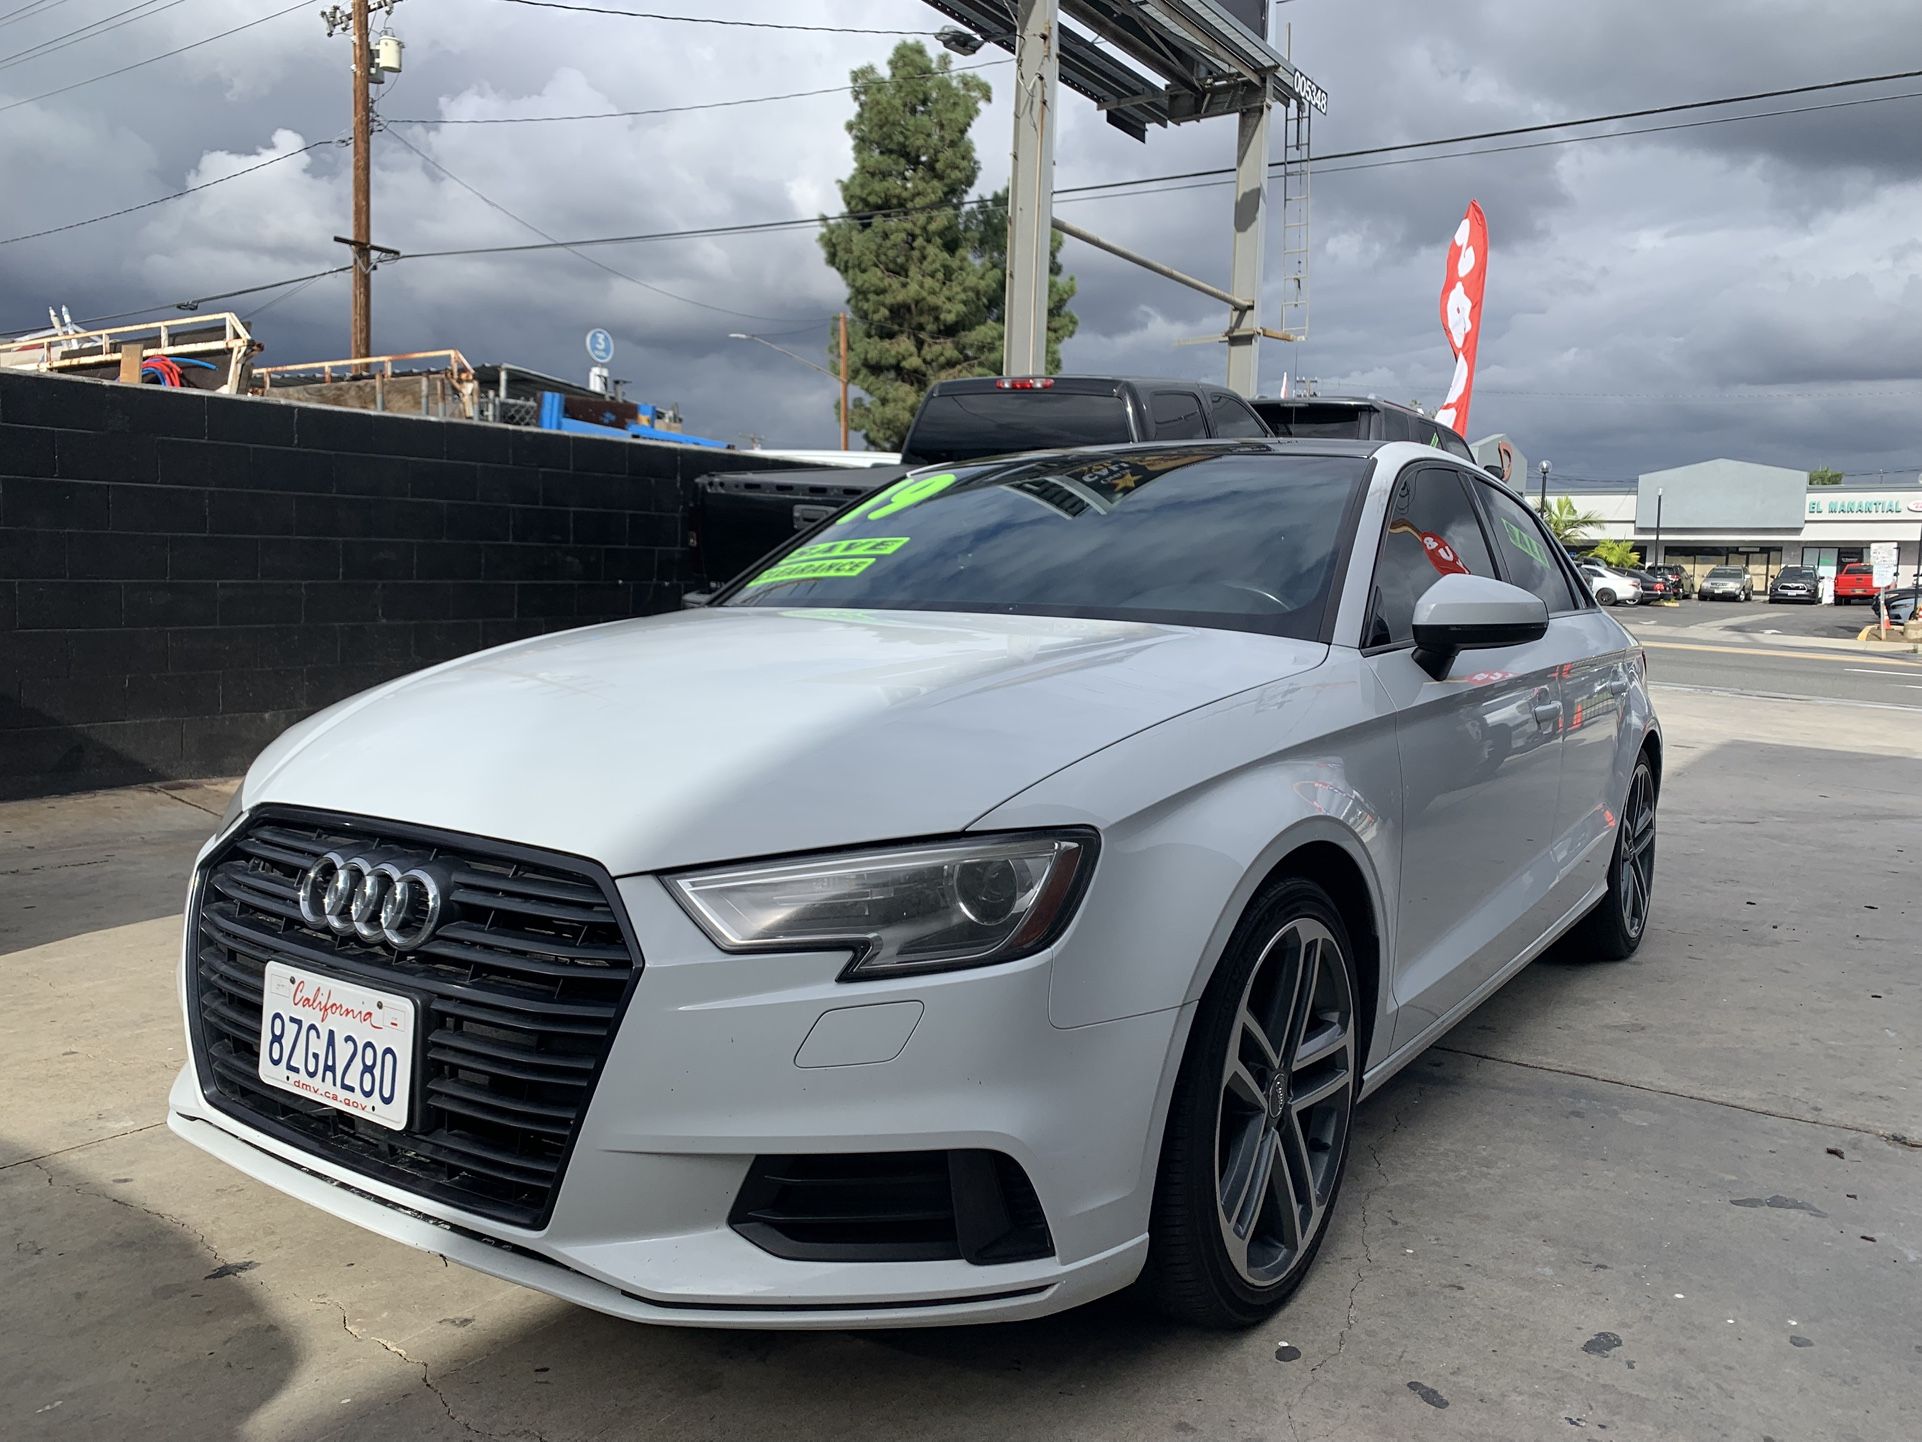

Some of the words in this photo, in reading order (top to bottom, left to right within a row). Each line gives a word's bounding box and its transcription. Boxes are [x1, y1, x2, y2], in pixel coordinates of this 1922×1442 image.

[1294, 71, 1327, 113] 005348
[1808, 500, 1823, 513] EL
[1828, 500, 1902, 513] MANANTIAL
[292, 980, 384, 1030] California
[268, 1012, 397, 1105] 8ZGA280
[293, 1079, 368, 1111] dmv.ca.gov
